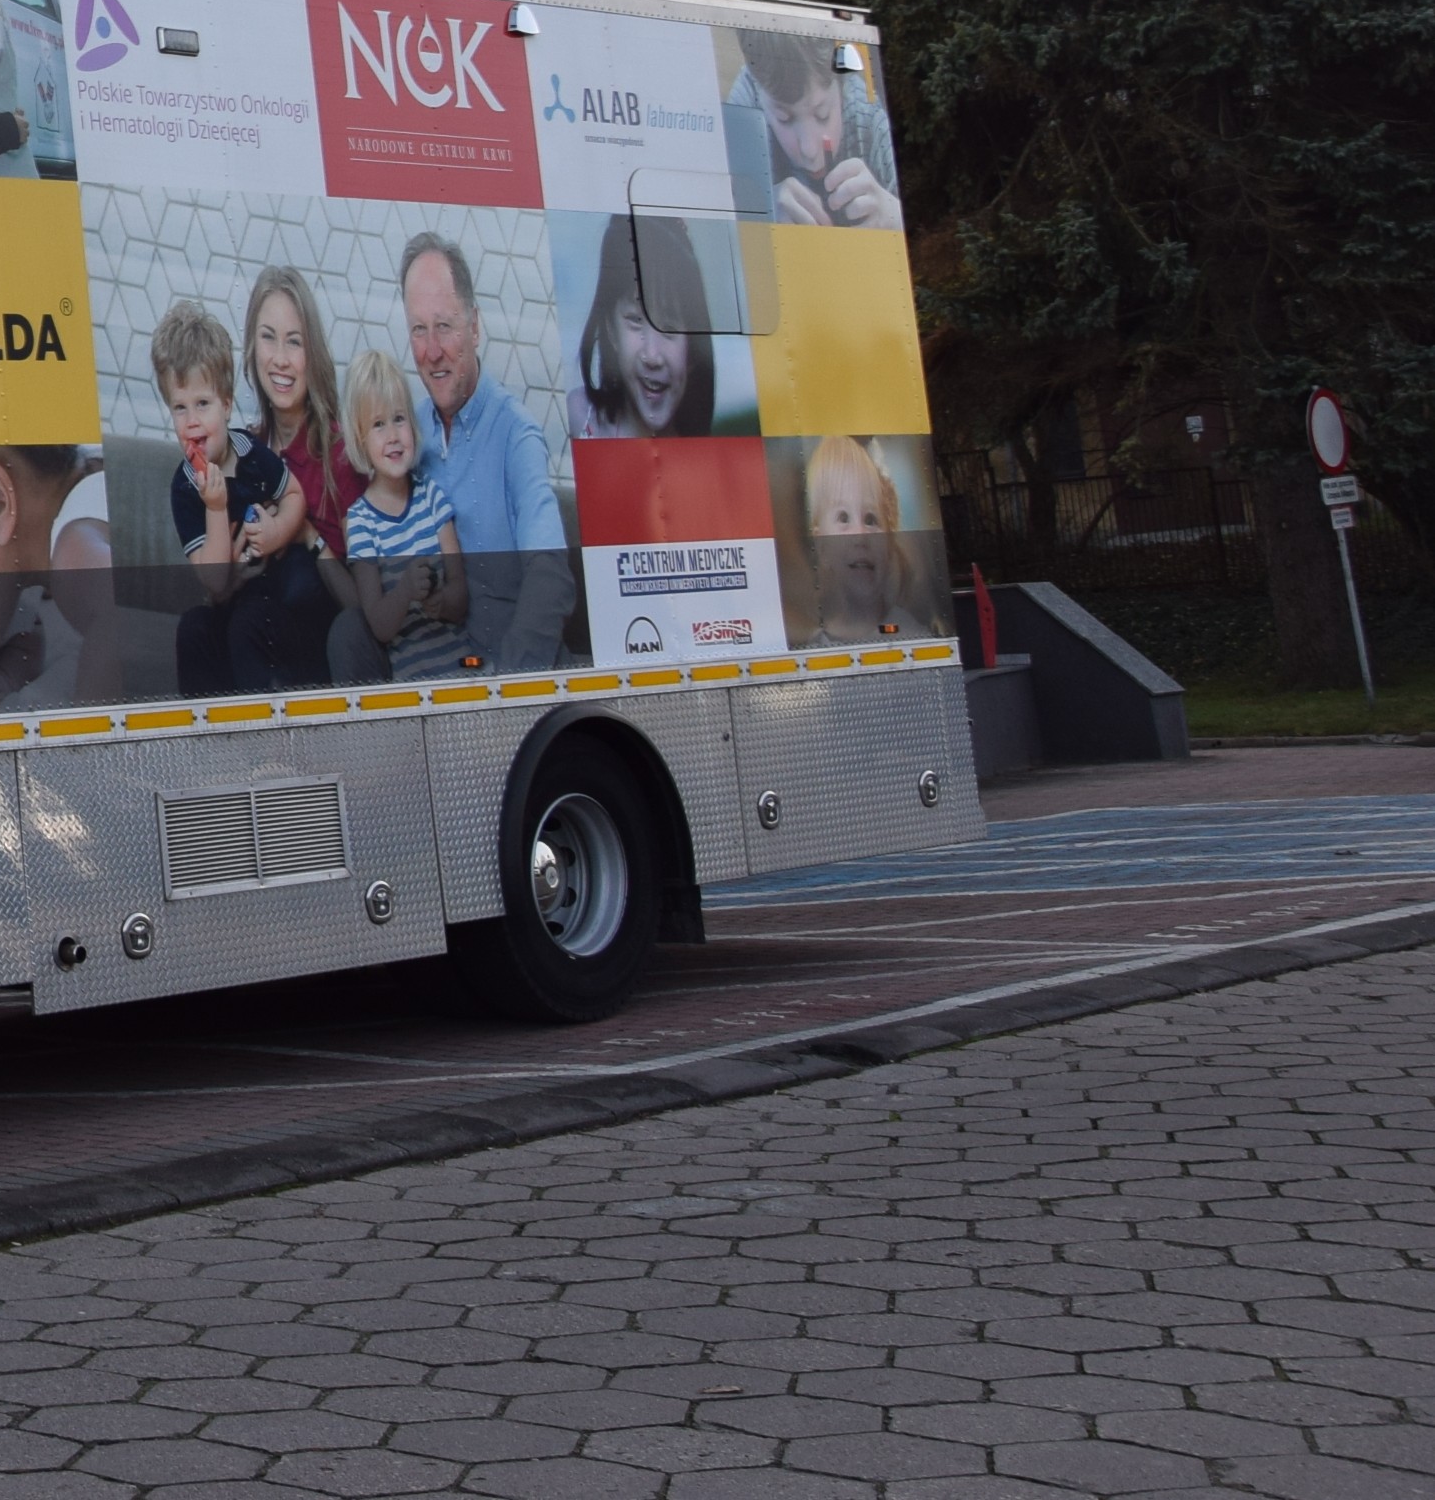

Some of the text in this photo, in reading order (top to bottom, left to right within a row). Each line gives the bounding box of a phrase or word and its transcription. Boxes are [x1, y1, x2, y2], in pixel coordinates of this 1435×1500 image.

[337, 0, 507, 112] NCK
[77, 79, 310, 124] Polskie Towarzystwo Onkologii
[582, 87, 714, 133] ALAB laboratoria
[79, 110, 261, 149] i Hematologii Dziecięcej
[347, 137, 513, 162] NARODOWE CENTRUM KRWI
[632, 546, 747, 575] CENTRUM MEDYCZNE
[628, 640, 661, 654] MAN
